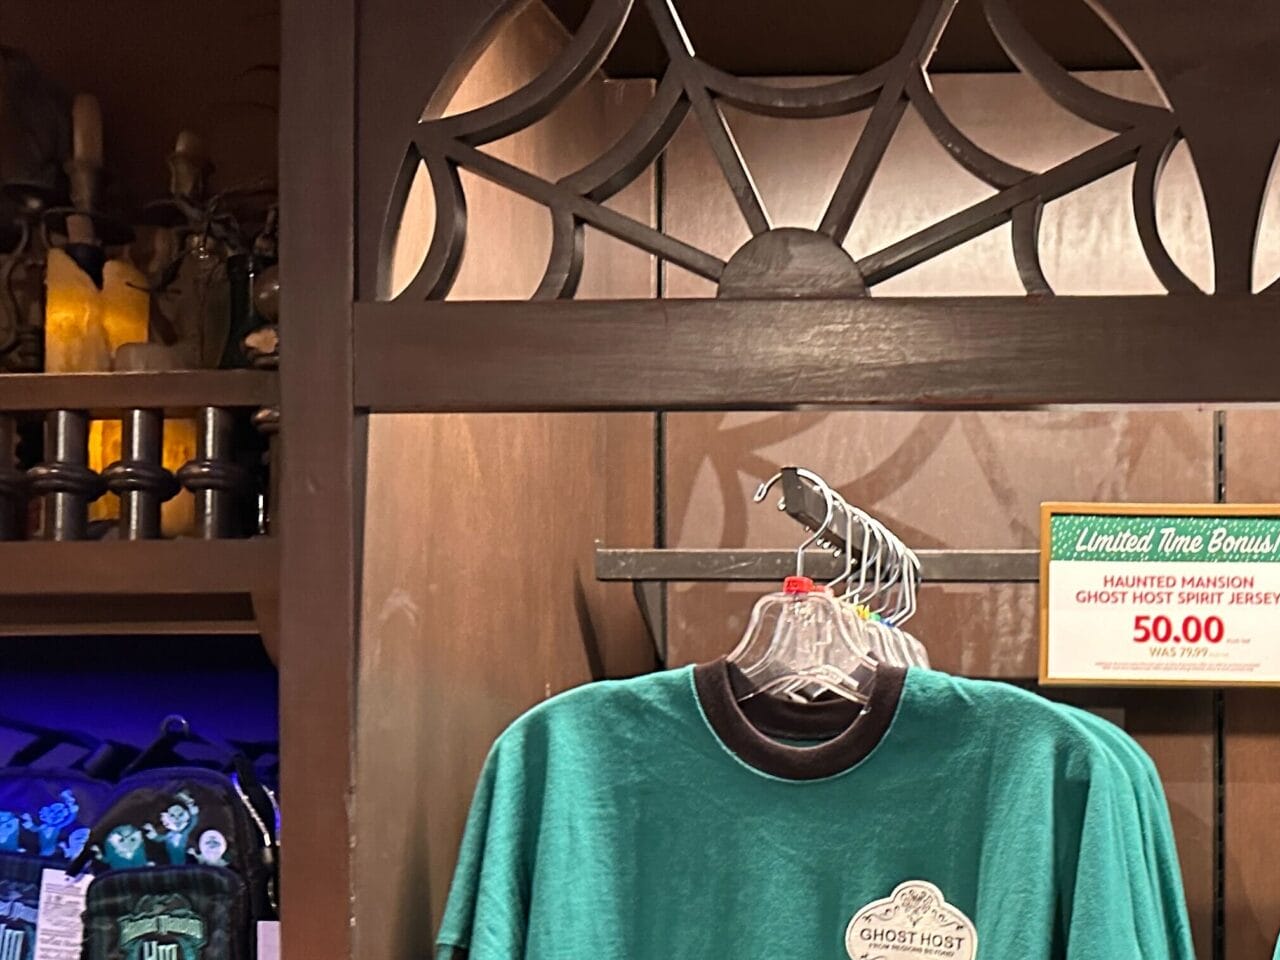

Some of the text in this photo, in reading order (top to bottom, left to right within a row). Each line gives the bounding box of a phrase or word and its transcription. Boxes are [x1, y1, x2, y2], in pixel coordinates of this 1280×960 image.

[1075, 526, 1153, 554] Limited
[1158, 528, 1204, 555] Time
[1103, 575, 1255, 589] HAUNTED MANSION
[1075, 590, 1128, 604] GHOST
[1132, 591, 1173, 604] HOST
[1177, 592, 1224, 605] SPIRIT
[1133, 615, 1225, 644] 50.00
[1149, 647, 1177, 657] WAS
[860, 928, 917, 944] GHOST
[921, 932, 965, 950] HOST
